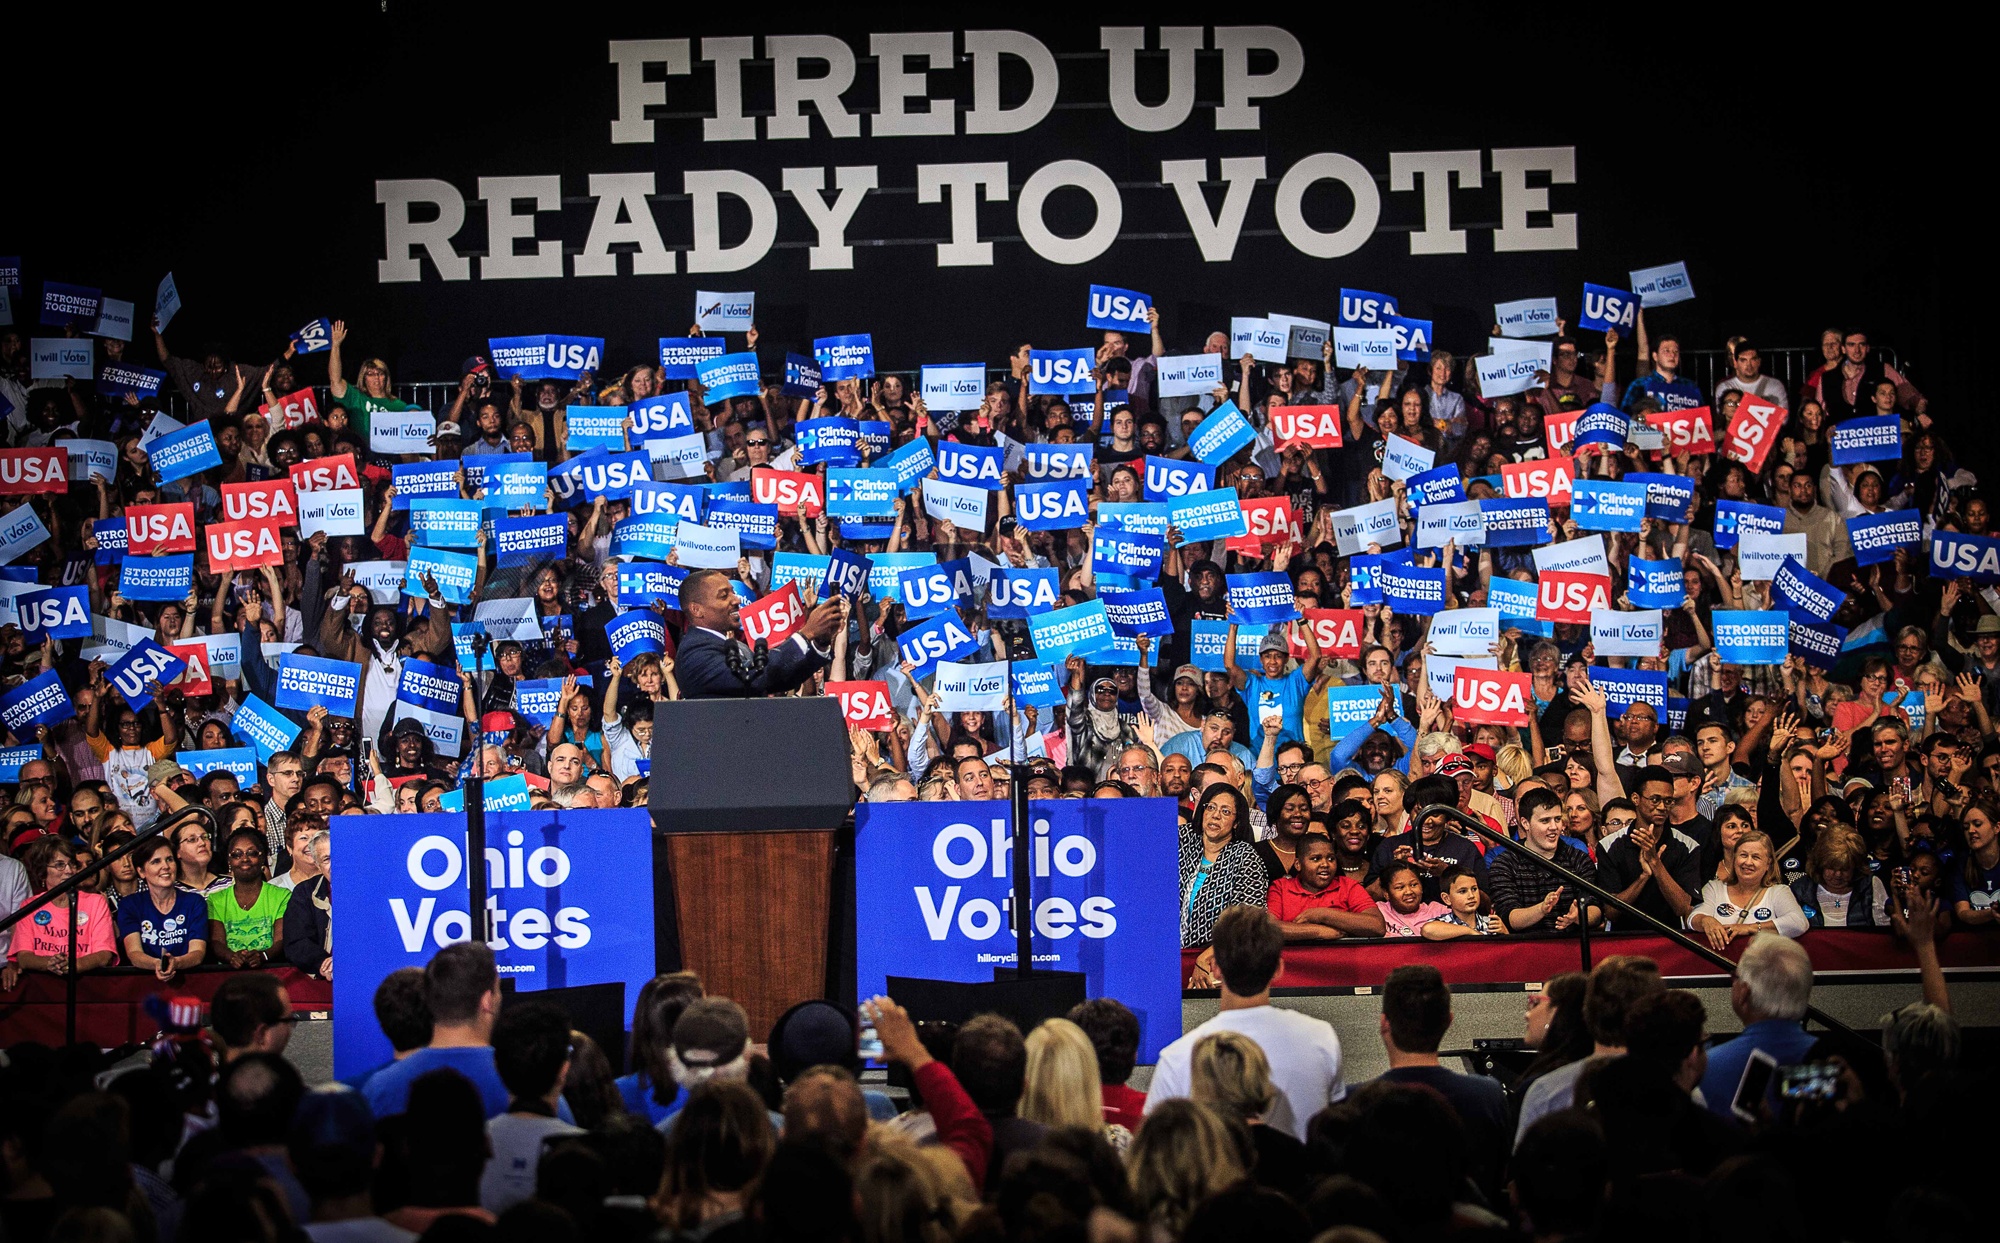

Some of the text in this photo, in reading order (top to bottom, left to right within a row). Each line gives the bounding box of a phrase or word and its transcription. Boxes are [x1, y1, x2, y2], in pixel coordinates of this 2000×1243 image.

[609, 26, 1304, 143] FIRED UP
[376, 146, 1578, 282] READY TO VOTE
[46, 293, 98, 308] STRONGER
[1092, 294, 1149, 322] USA
[45, 302, 96, 317] TOGETHER
[1506, 314, 1522, 324] will
[1528, 309, 1550, 322] Vote
[1586, 292, 1634, 328] USA
[301, 320, 329, 351] USA
[663, 347, 722, 356] STRONGER
[831, 345, 870, 357] Clinton
[1342, 343, 1359, 352] will
[1365, 341, 1388, 353] Vote
[41, 352, 58, 362] will
[63, 350, 86, 362] Vote
[547, 343, 599, 370] USA
[833, 355, 864, 366] Kaine
[701, 363, 756, 381] STRONGER
[1032, 357, 1093, 383] USA
[1167, 371, 1185, 380] will
[1191, 367, 1215, 380] Vote
[1488, 369, 1507, 380] will
[1511, 361, 1535, 376] Vote
[702, 372, 758, 388] TOGETHER
[931, 384, 948, 392] will
[954, 381, 977, 393] Vote
[629, 402, 690, 434] USA
[380, 427, 398, 436] will
[405, 424, 428, 437] Vote
[818, 427, 859, 439] Clinton
[1274, 414, 1339, 440] USA
[1729, 405, 1776, 462] USA
[1834, 426, 1897, 440] STRONGER
[152, 433, 210, 462] STRONGER
[819, 436, 852, 447] Kaine
[1835, 435, 1898, 449] TOGETHER
[153, 442, 213, 471] TOGETHER
[939, 450, 1000, 479] USA
[1, 458, 65, 483] USA
[1027, 452, 1090, 478] USA
[396, 472, 455, 487] STRONGER
[503, 474, 545, 484] Clinton
[585, 459, 650, 488] USA
[1507, 468, 1572, 495] USA
[397, 482, 457, 495] TOGETHER
[504, 485, 537, 495] Kaine
[755, 478, 822, 506] USA
[853, 480, 896, 490] Clinton
[1423, 477, 1459, 492] Clinton
[1647, 483, 1690, 497] Clinton
[854, 490, 888, 501] Kaine
[1426, 488, 1456, 502] Kaine
[1598, 492, 1643, 506] Clinton
[1647, 493, 1681, 507] Kaine
[226, 491, 293, 520] USA
[308, 508, 323, 519] will
[331, 502, 355, 518] Vote
[1018, 490, 1086, 520] USA
[1172, 501, 1237, 521] STRONGER
[1599, 504, 1634, 516] Kaine
[413, 510, 478, 521] STRONGER
[710, 511, 775, 525] STRONGER
[1174, 511, 1240, 531] TOGETHER
[1428, 519, 1446, 528] will
[1454, 515, 1478, 528] Vote
[1482, 508, 1546, 521] STRONGER
[129, 513, 192, 542] USA
[413, 520, 478, 531] TOGETHER
[709, 521, 774, 534] TOGETHER
[1344, 524, 1364, 536] will
[1369, 515, 1392, 529] Vote
[1483, 518, 1548, 530] TOGETHER
[1853, 522, 1920, 541] STRONGER
[500, 526, 564, 542] STRONGER
[1855, 532, 1920, 551] TOGETHER
[211, 528, 279, 560] USA
[500, 536, 564, 551] TOGETHER
[678, 538, 736, 551] iwillvote.com
[1118, 542, 1161, 556] Clinton
[1118, 555, 1151, 567] Kaine
[1934, 540, 2000, 572] USA
[124, 567, 189, 578] STRONGER
[1648, 571, 1683, 585] Clinton
[124, 576, 189, 587] TOGETHER
[903, 570, 972, 607] USA
[1382, 573, 1442, 590] STRONGER
[1648, 582, 1681, 594] Kaine
[991, 578, 1056, 607] USA
[1231, 584, 1292, 598] STRONGER
[1382, 583, 1442, 600] TOGETHER
[1541, 582, 1610, 612] USA
[1776, 575, 1829, 620] TOGETHER
[1780, 567, 1836, 613] STRONGER
[1105, 602, 1164, 614] STRONGER
[1232, 595, 1294, 608] TOGETHER
[21, 597, 89, 632] USA
[745, 593, 803, 640] USA
[1108, 611, 1166, 624] TOGETHER
[611, 620, 664, 643] STRONGER
[1033, 613, 1104, 641] STRONGER
[1439, 625, 1457, 635] will
[1464, 622, 1489, 635] Vote
[1600, 627, 1619, 637] will
[1627, 624, 1653, 638] Vote
[1717, 625, 1785, 635] STRONGER
[613, 629, 665, 652] TOGETHER
[901, 622, 971, 667] USA
[1036, 624, 1107, 650] TOGETHER
[1717, 636, 1785, 647] TOGETHER
[212, 648, 235, 662] Vote
[114, 647, 176, 698] USA
[283, 668, 355, 687] STRONGER
[1018, 671, 1053, 683] Clinton
[281, 679, 354, 699] TOGETHER
[404, 672, 459, 693] STRONGER
[944, 682, 966, 691] will
[974, 679, 1000, 691] Vote
[1021, 682, 1049, 695] Kaine
[402, 682, 457, 703] TOGETHER
[1457, 677, 1524, 713] USA
[1, 682, 61, 721] STRONGER
[8, 693, 66, 730] TOGETHER
[240, 705, 289, 745] STRONGER
[234, 715, 285, 753] TOGETHER
[933, 819, 1096, 878] Ohio
[388, 895, 591, 952] Votes
[158, 928, 187, 938] Clinton
[159, 936, 183, 946] Kaine
[977, 954, 1060, 963] hillaryclin.com
